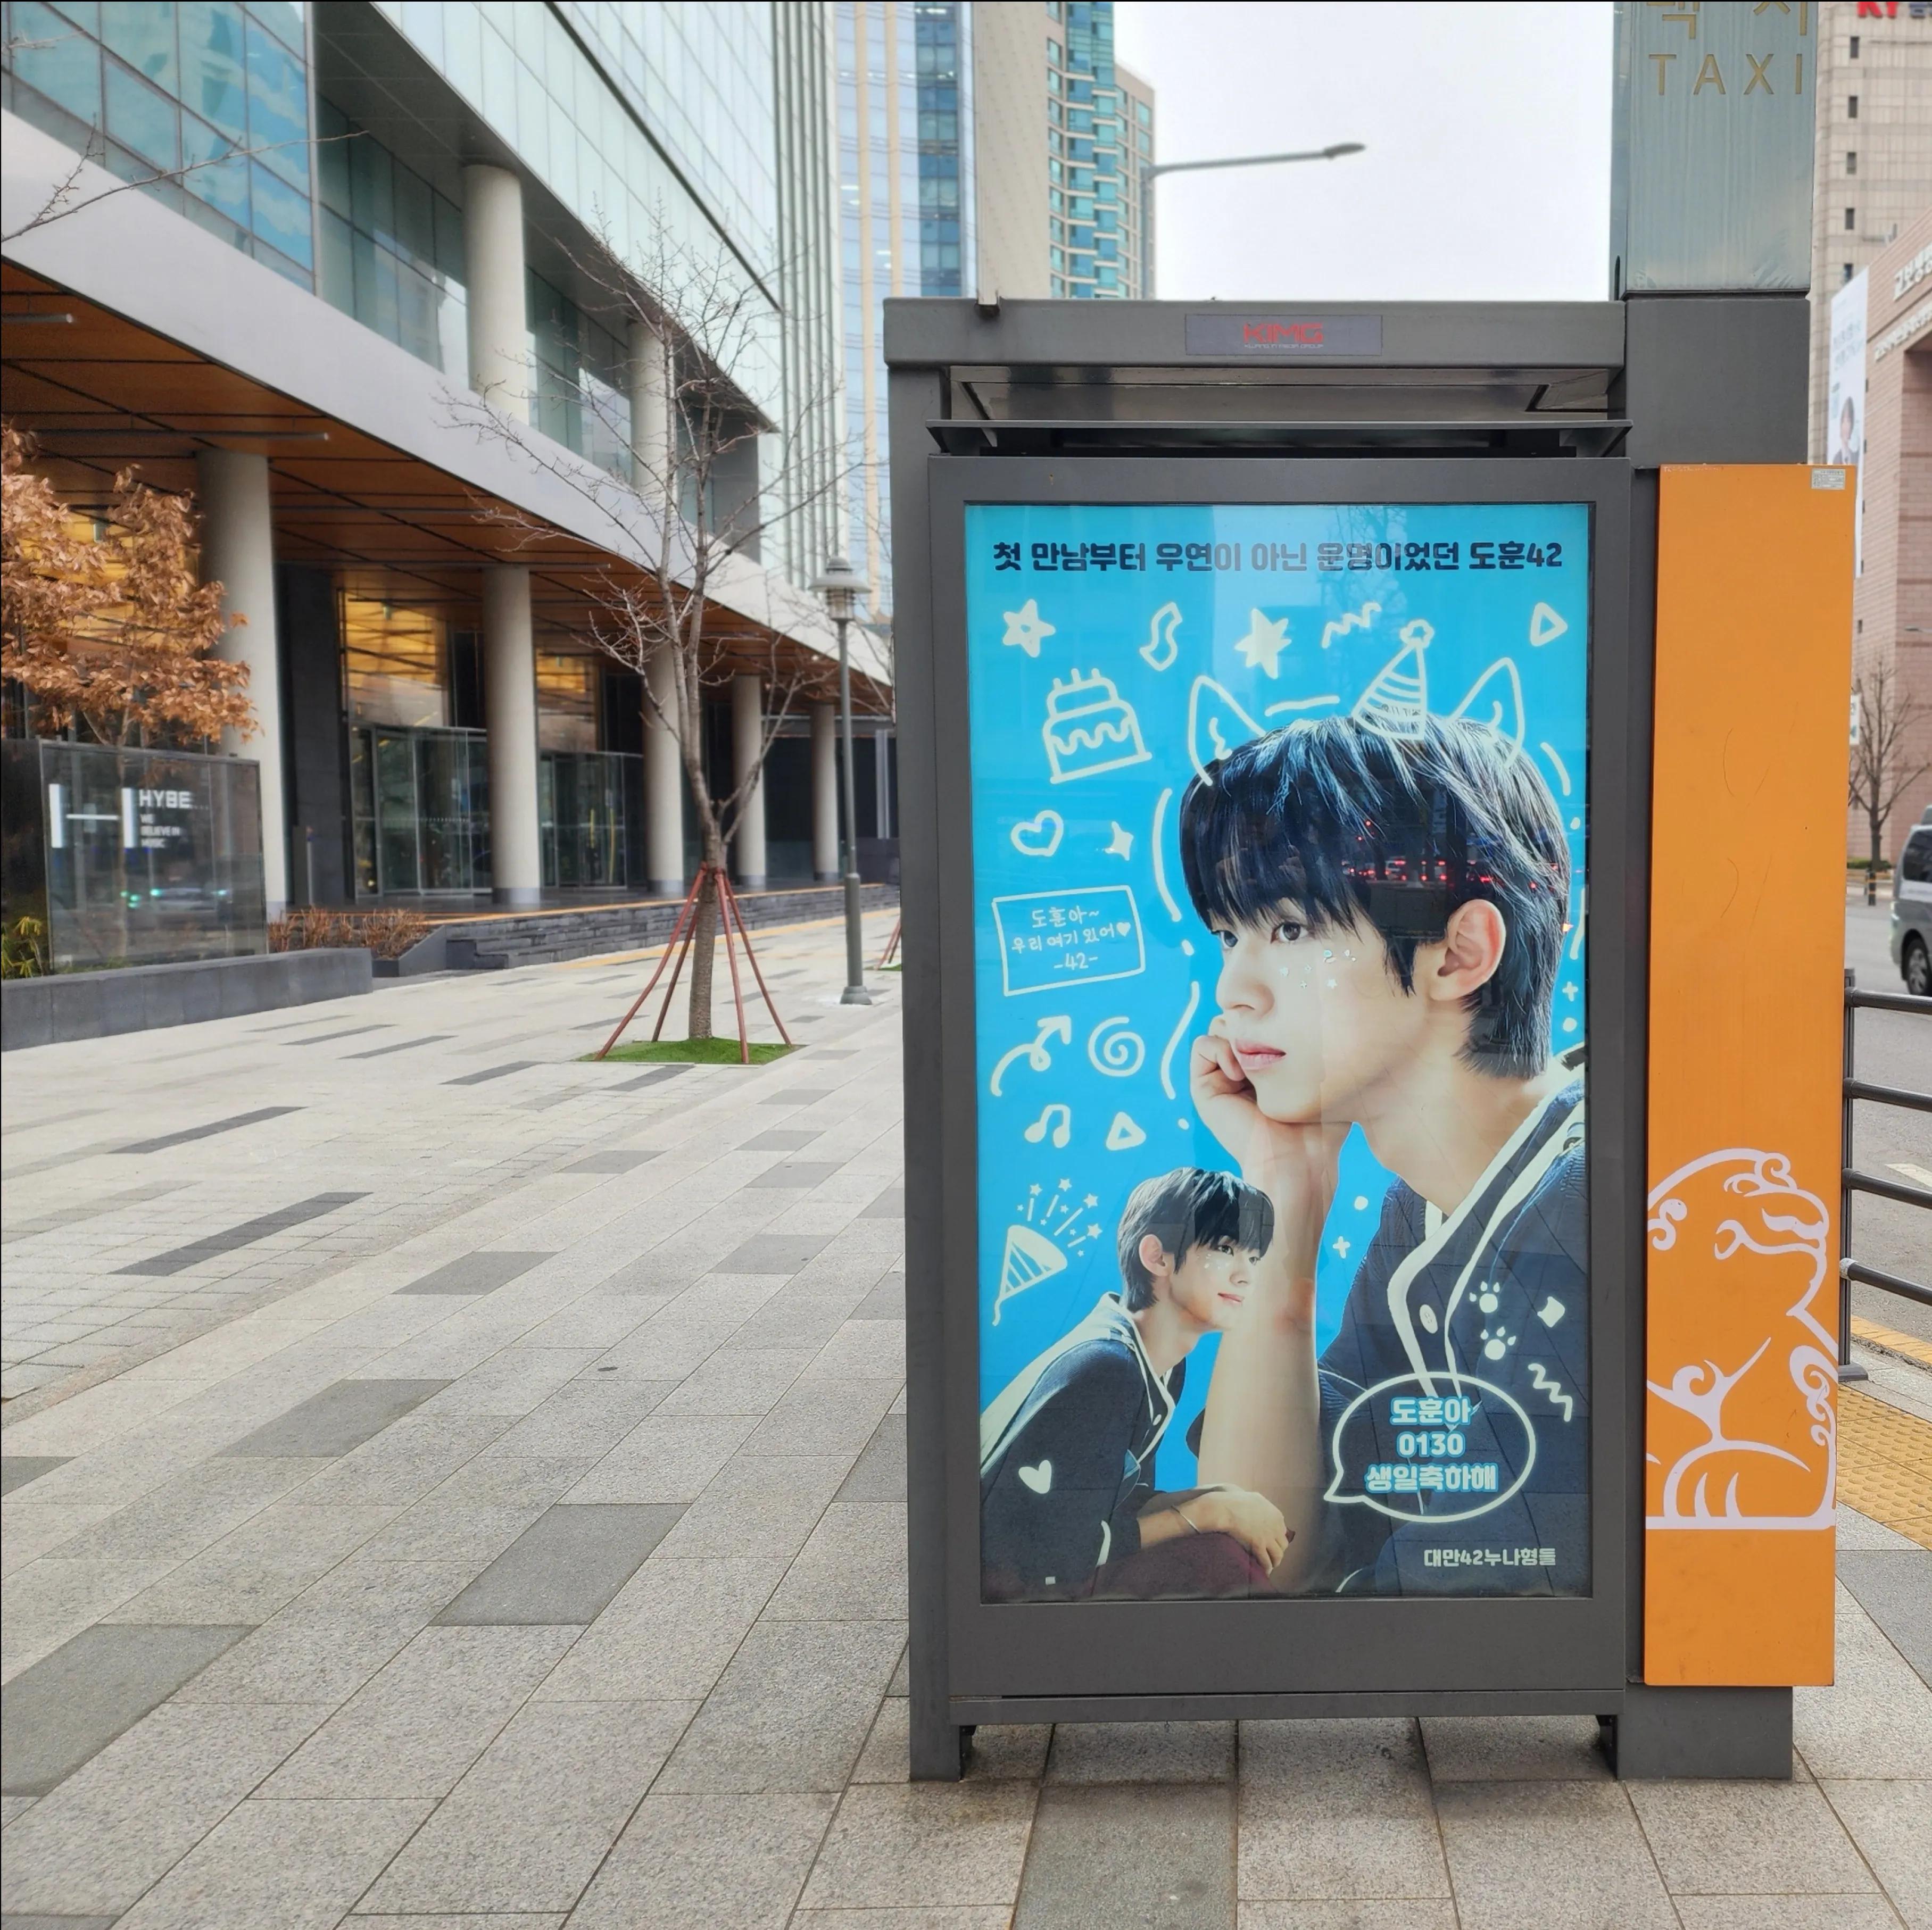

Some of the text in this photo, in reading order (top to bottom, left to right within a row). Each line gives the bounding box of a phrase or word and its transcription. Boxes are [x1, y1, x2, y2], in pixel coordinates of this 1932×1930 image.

[1649, 53, 1803, 96] TAXI
[1243, 323, 1323, 344] KIMG
[993, 540, 1563, 571] 첫 만남부터 우연이 아닌 운명이었던 도훈42
[139, 789, 193, 809] HYBE
[1011, 935, 1042, 953] 우리
[1390, 1396, 1472, 1426] 도훈아
[1397, 1432, 1466, 1457] 0130
[1365, 1463, 1498, 1492] 생일축하해
[1423, 1548, 1556, 1567] 대만42누나형들
